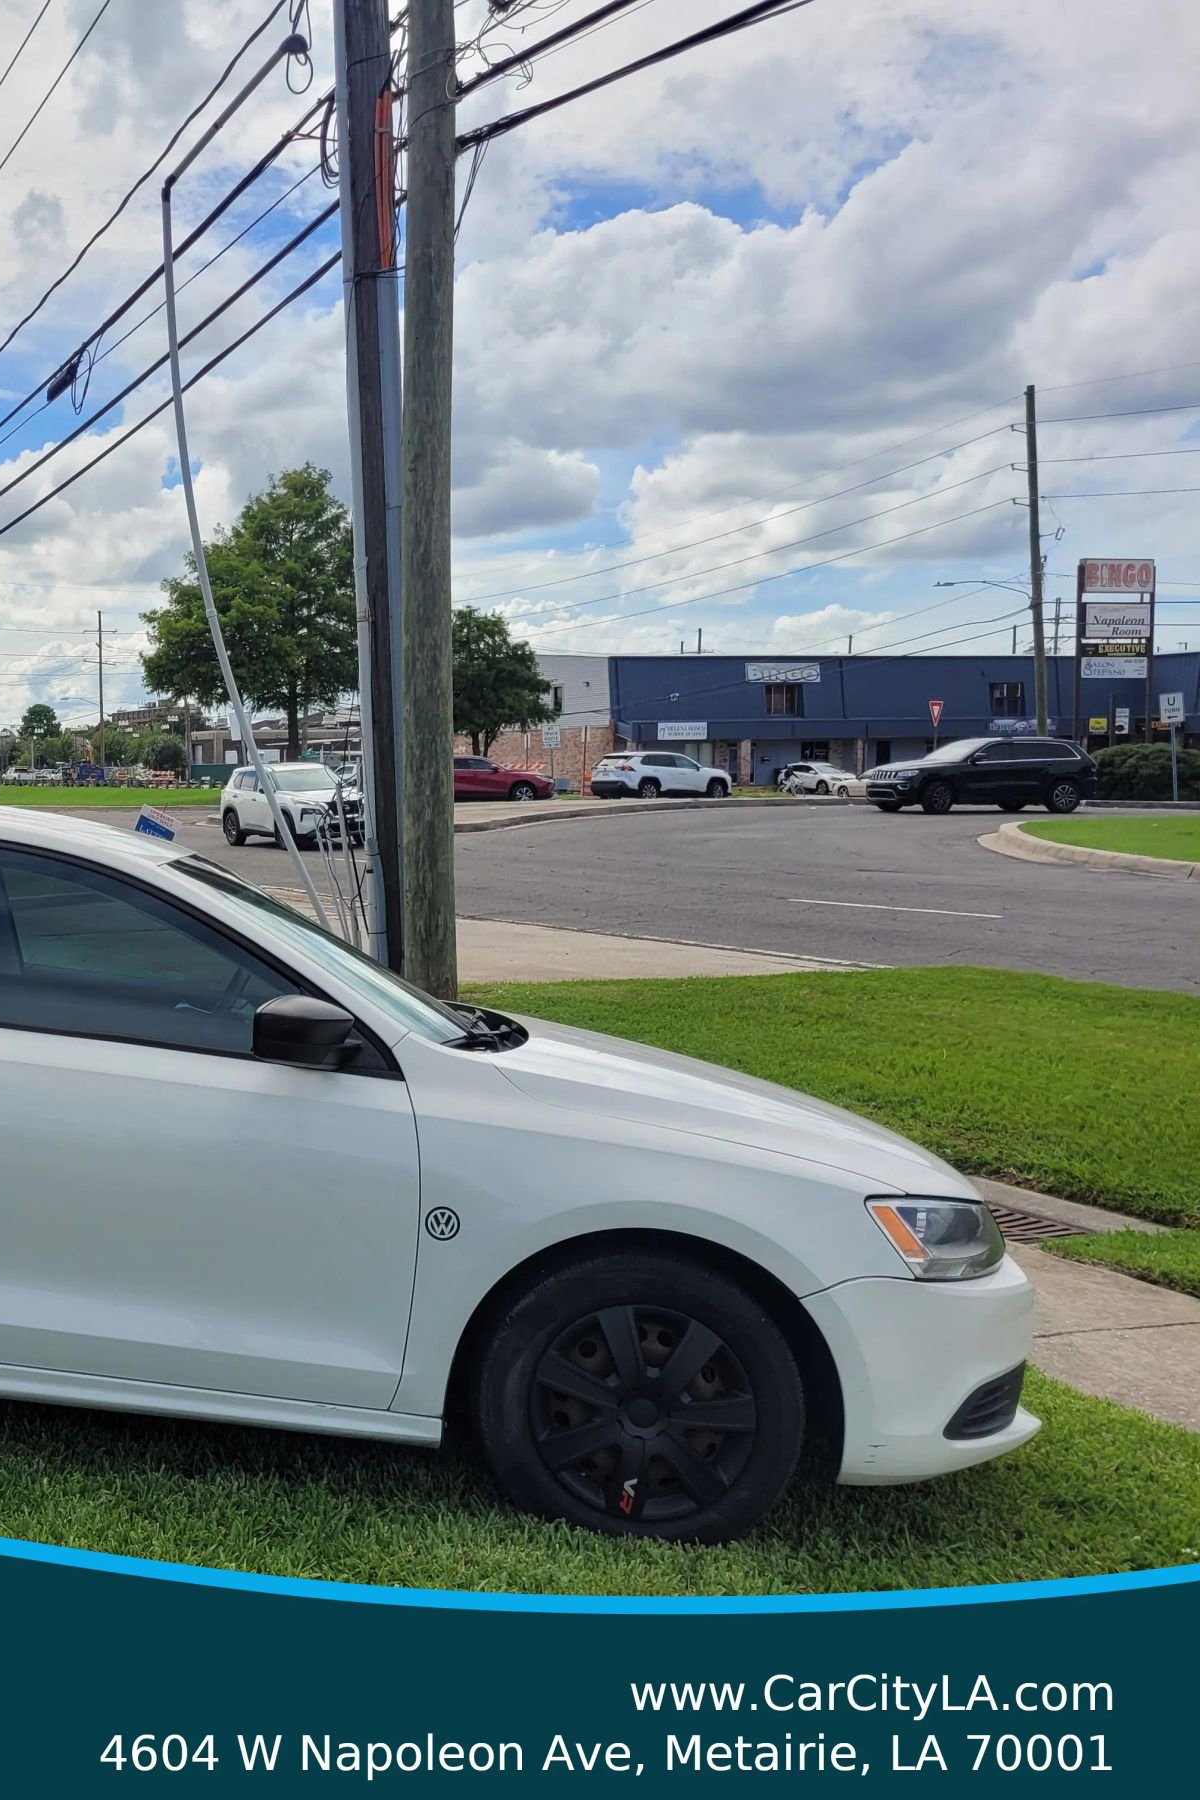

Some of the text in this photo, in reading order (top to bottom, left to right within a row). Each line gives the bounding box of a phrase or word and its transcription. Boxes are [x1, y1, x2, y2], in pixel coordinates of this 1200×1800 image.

[1086, 563, 1152, 588] BINGO
[1093, 615, 1145, 628] Napoleon
[1111, 626, 1142, 636] Room
[1098, 644, 1147, 654] EXECUTIVE
[747, 665, 819, 682] BINGO
[1167, 696, 1176, 706] U
